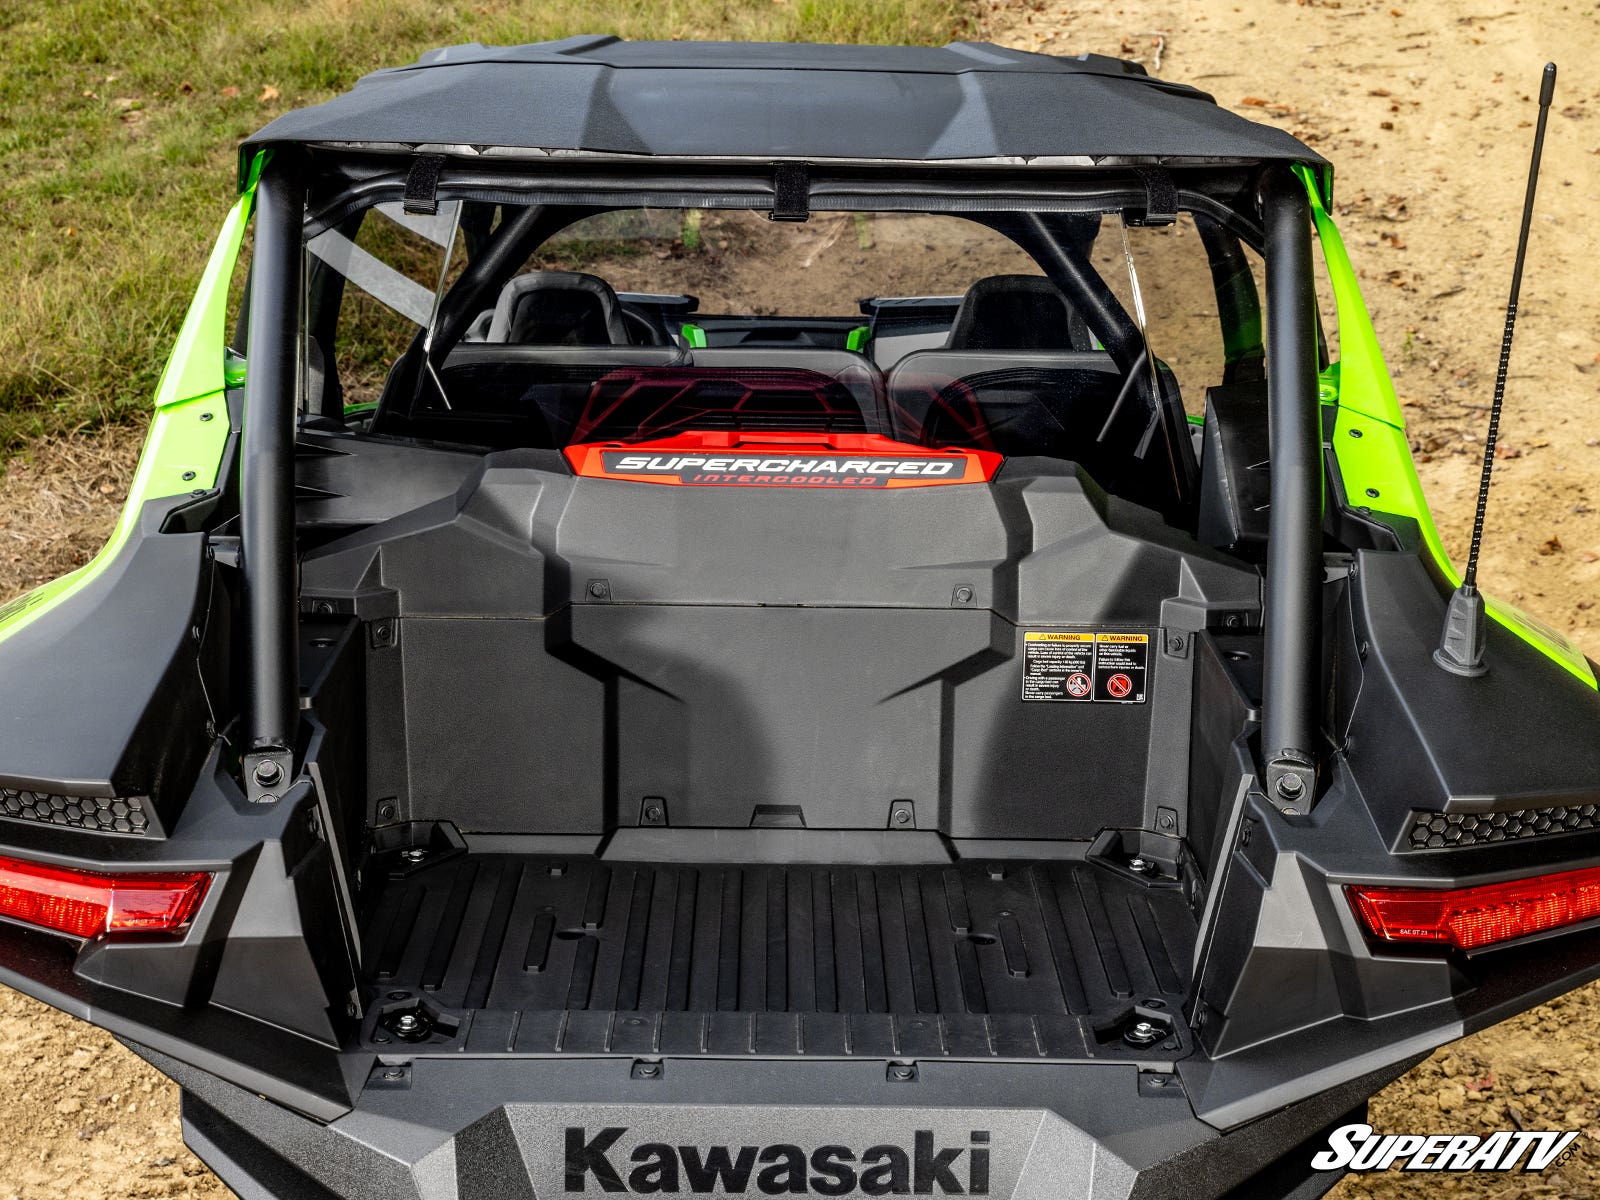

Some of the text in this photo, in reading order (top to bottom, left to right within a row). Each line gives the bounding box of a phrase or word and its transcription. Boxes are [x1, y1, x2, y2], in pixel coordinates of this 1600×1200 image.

[615, 456, 954, 476] SUPERCHARGED
[693, 474, 877, 486] INTERCOOLED
[565, 1127, 990, 1195] Kawasaki
